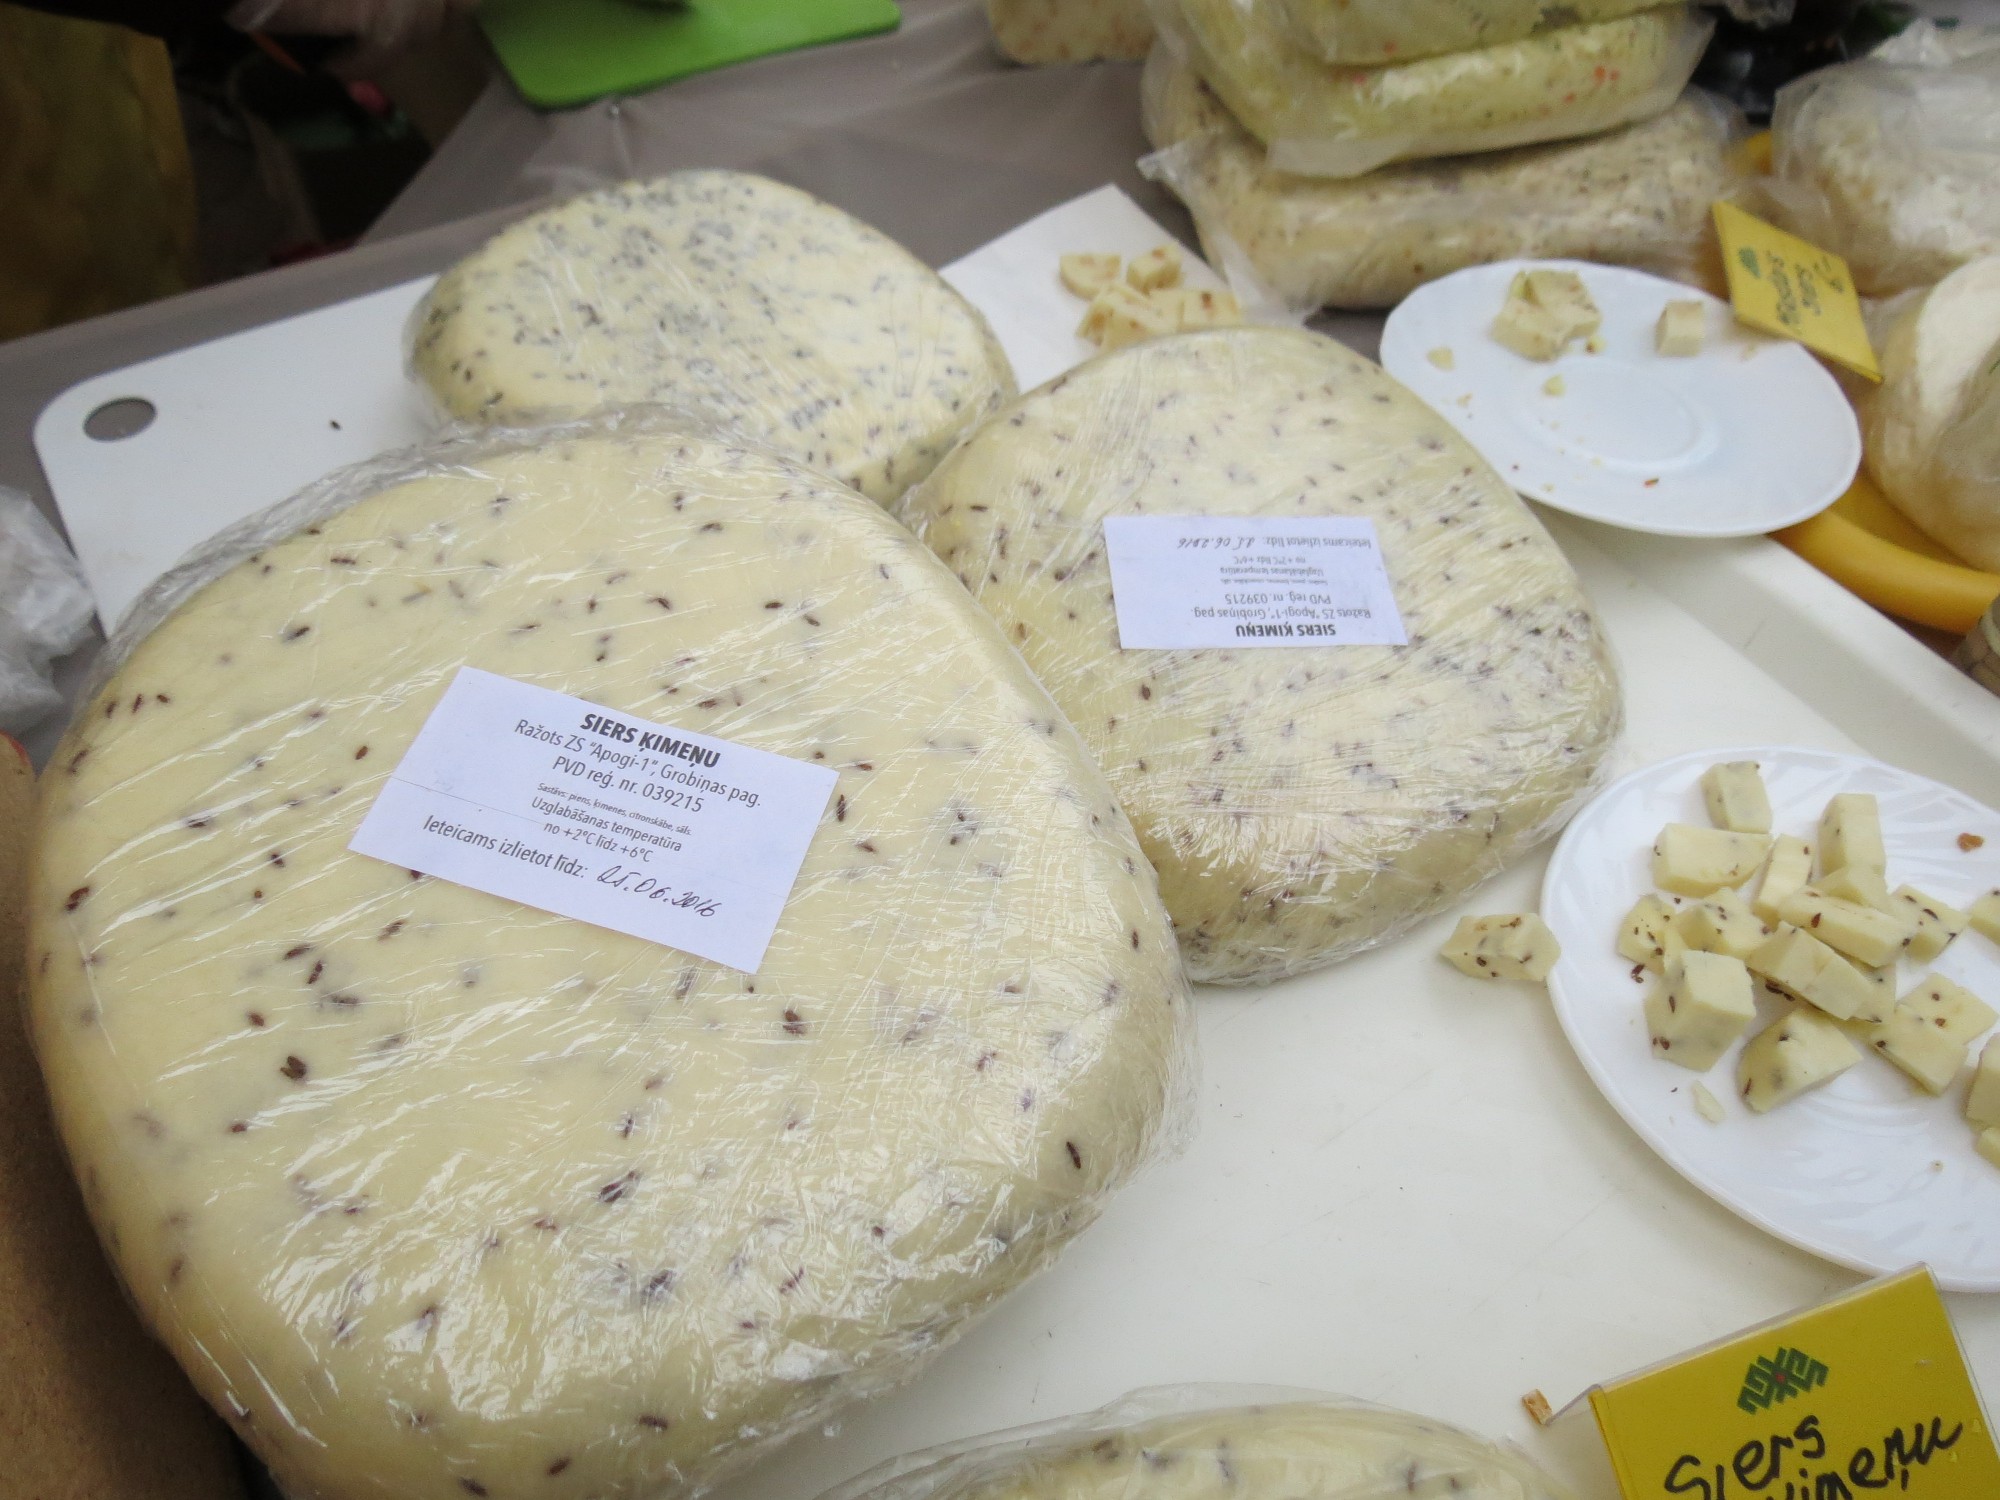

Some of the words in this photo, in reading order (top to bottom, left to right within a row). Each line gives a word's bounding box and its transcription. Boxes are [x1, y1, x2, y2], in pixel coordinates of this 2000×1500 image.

[1224, 593, 1268, 604] 039215
[1269, 593, 1284, 602] nr.
[1309, 595, 1331, 604] PVD
[1191, 608, 1214, 617] pag.
[1216, 608, 1266, 620] Grobiņas
[1321, 608, 1335, 619] ZS
[1336, 609, 1371, 618] Ražots
[1235, 622, 1293, 636] ĶIMEŅU
[1296, 624, 1336, 636] SIERS
[579, 713, 639, 744] SIERS
[637, 731, 721, 768] ĶIMEŅU
[514, 718, 564, 746] Ražots
[563, 734, 587, 753] ZS
[660, 763, 728, 795] Grobiņas
[727, 787, 761, 809] pag.
[552, 755, 586, 777] PVD
[586, 769, 614, 789] reģ.
[618, 778, 639, 794] nr.
[642, 782, 705, 813] 039215
[531, 796, 611, 830] Uzglabāšanas
[610, 821, 682, 852] temperatūra
[567, 793, 592, 807] piens,
[628, 812, 674, 832] citronskābe,
[674, 825, 692, 836] sāls.
[422, 814, 498, 850] Ieteicams
[497, 838, 554, 868] izlietot
[553, 853, 589, 879] līdz:
[543, 822, 561, 835] no
[595, 834, 619, 852] līdz
[1665, 1415, 1826, 1500] Siers
[1766, 1417, 1962, 1500] imeņu
